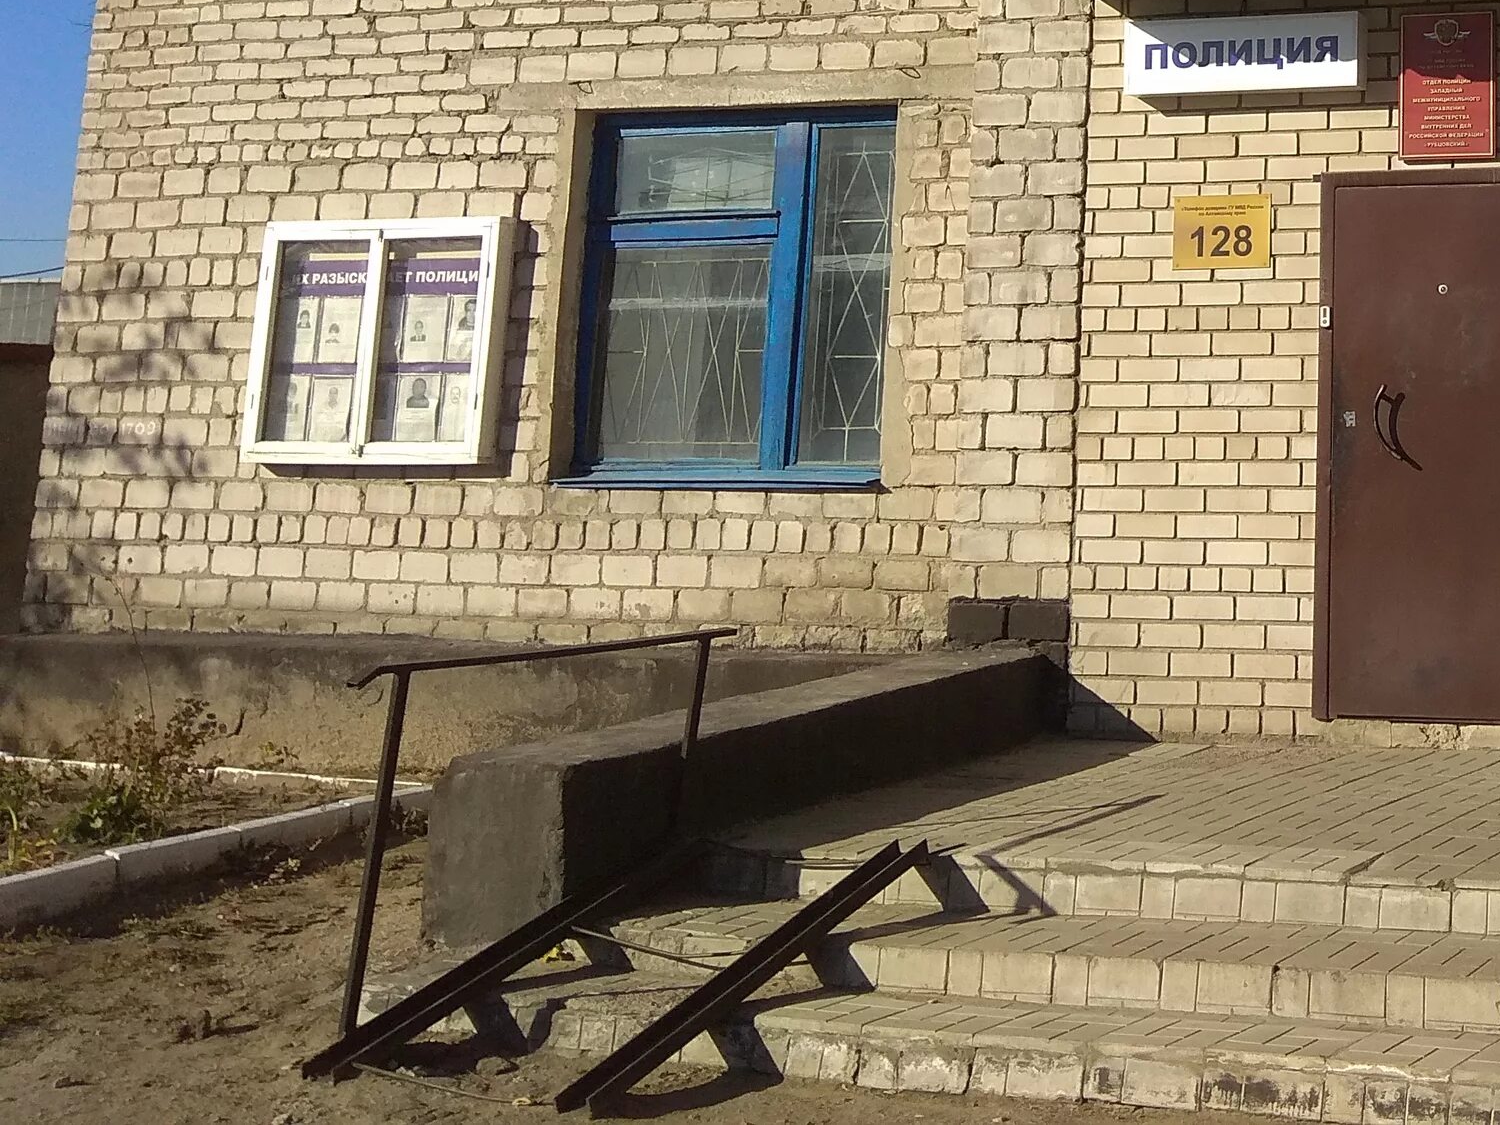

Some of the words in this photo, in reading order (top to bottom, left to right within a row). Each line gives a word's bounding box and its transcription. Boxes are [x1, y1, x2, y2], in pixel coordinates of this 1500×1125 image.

[1144, 35, 1339, 70] ПОЛИЦИЯ
[1190, 225, 1253, 257] 128
[415, 270, 479, 284] ПОЛИЦИ
[122, 421, 156, 436] 1709
